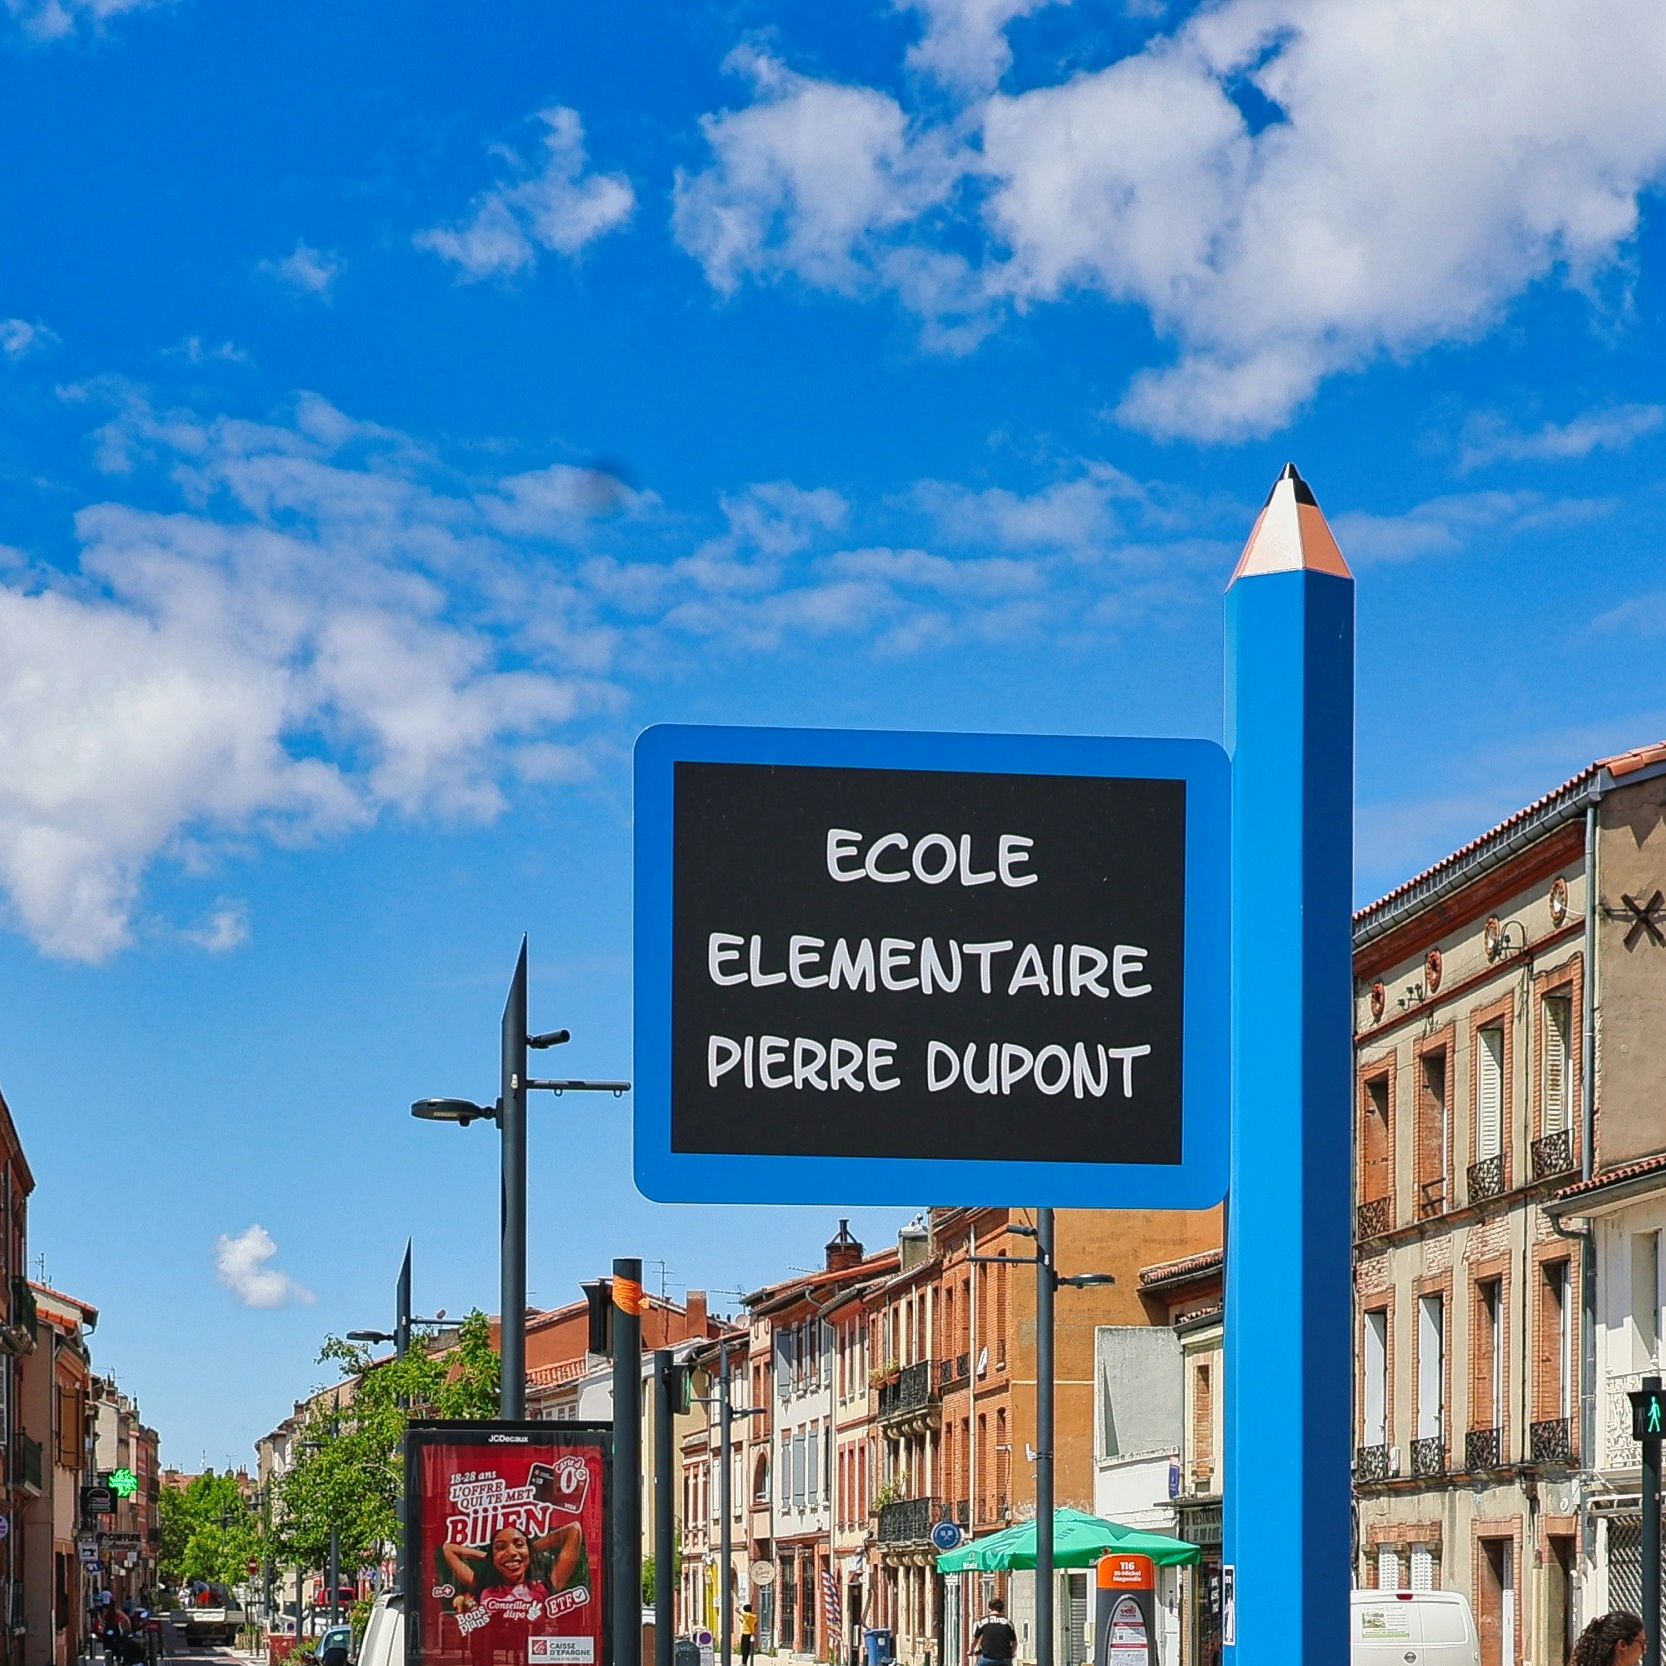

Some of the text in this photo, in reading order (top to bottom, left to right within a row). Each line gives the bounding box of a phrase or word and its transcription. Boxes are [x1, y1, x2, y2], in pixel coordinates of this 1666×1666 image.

[827, 829, 1038, 887] ECOLE
[708, 933, 1152, 998] ELEMENTAIRE
[708, 1035, 1151, 1099] PIERRE DUPONT
[488, 1434, 529, 1443] JCDecaux
[450, 1471, 497, 1484] 18-28 ans
[451, 1482, 504, 1499] L'OFFRE
[460, 1487, 535, 1510] QUI TE MET
[1120, 1561, 1135, 1570] 116
[488, 1600, 531, 1612] Conseiller
[548, 1594, 574, 1615] ETF
[455, 1606, 487, 1625] Bons
[503, 1609, 526, 1621] dispo
[459, 1616, 491, 1637] plans
[549, 1642, 576, 1650] CAISSE
